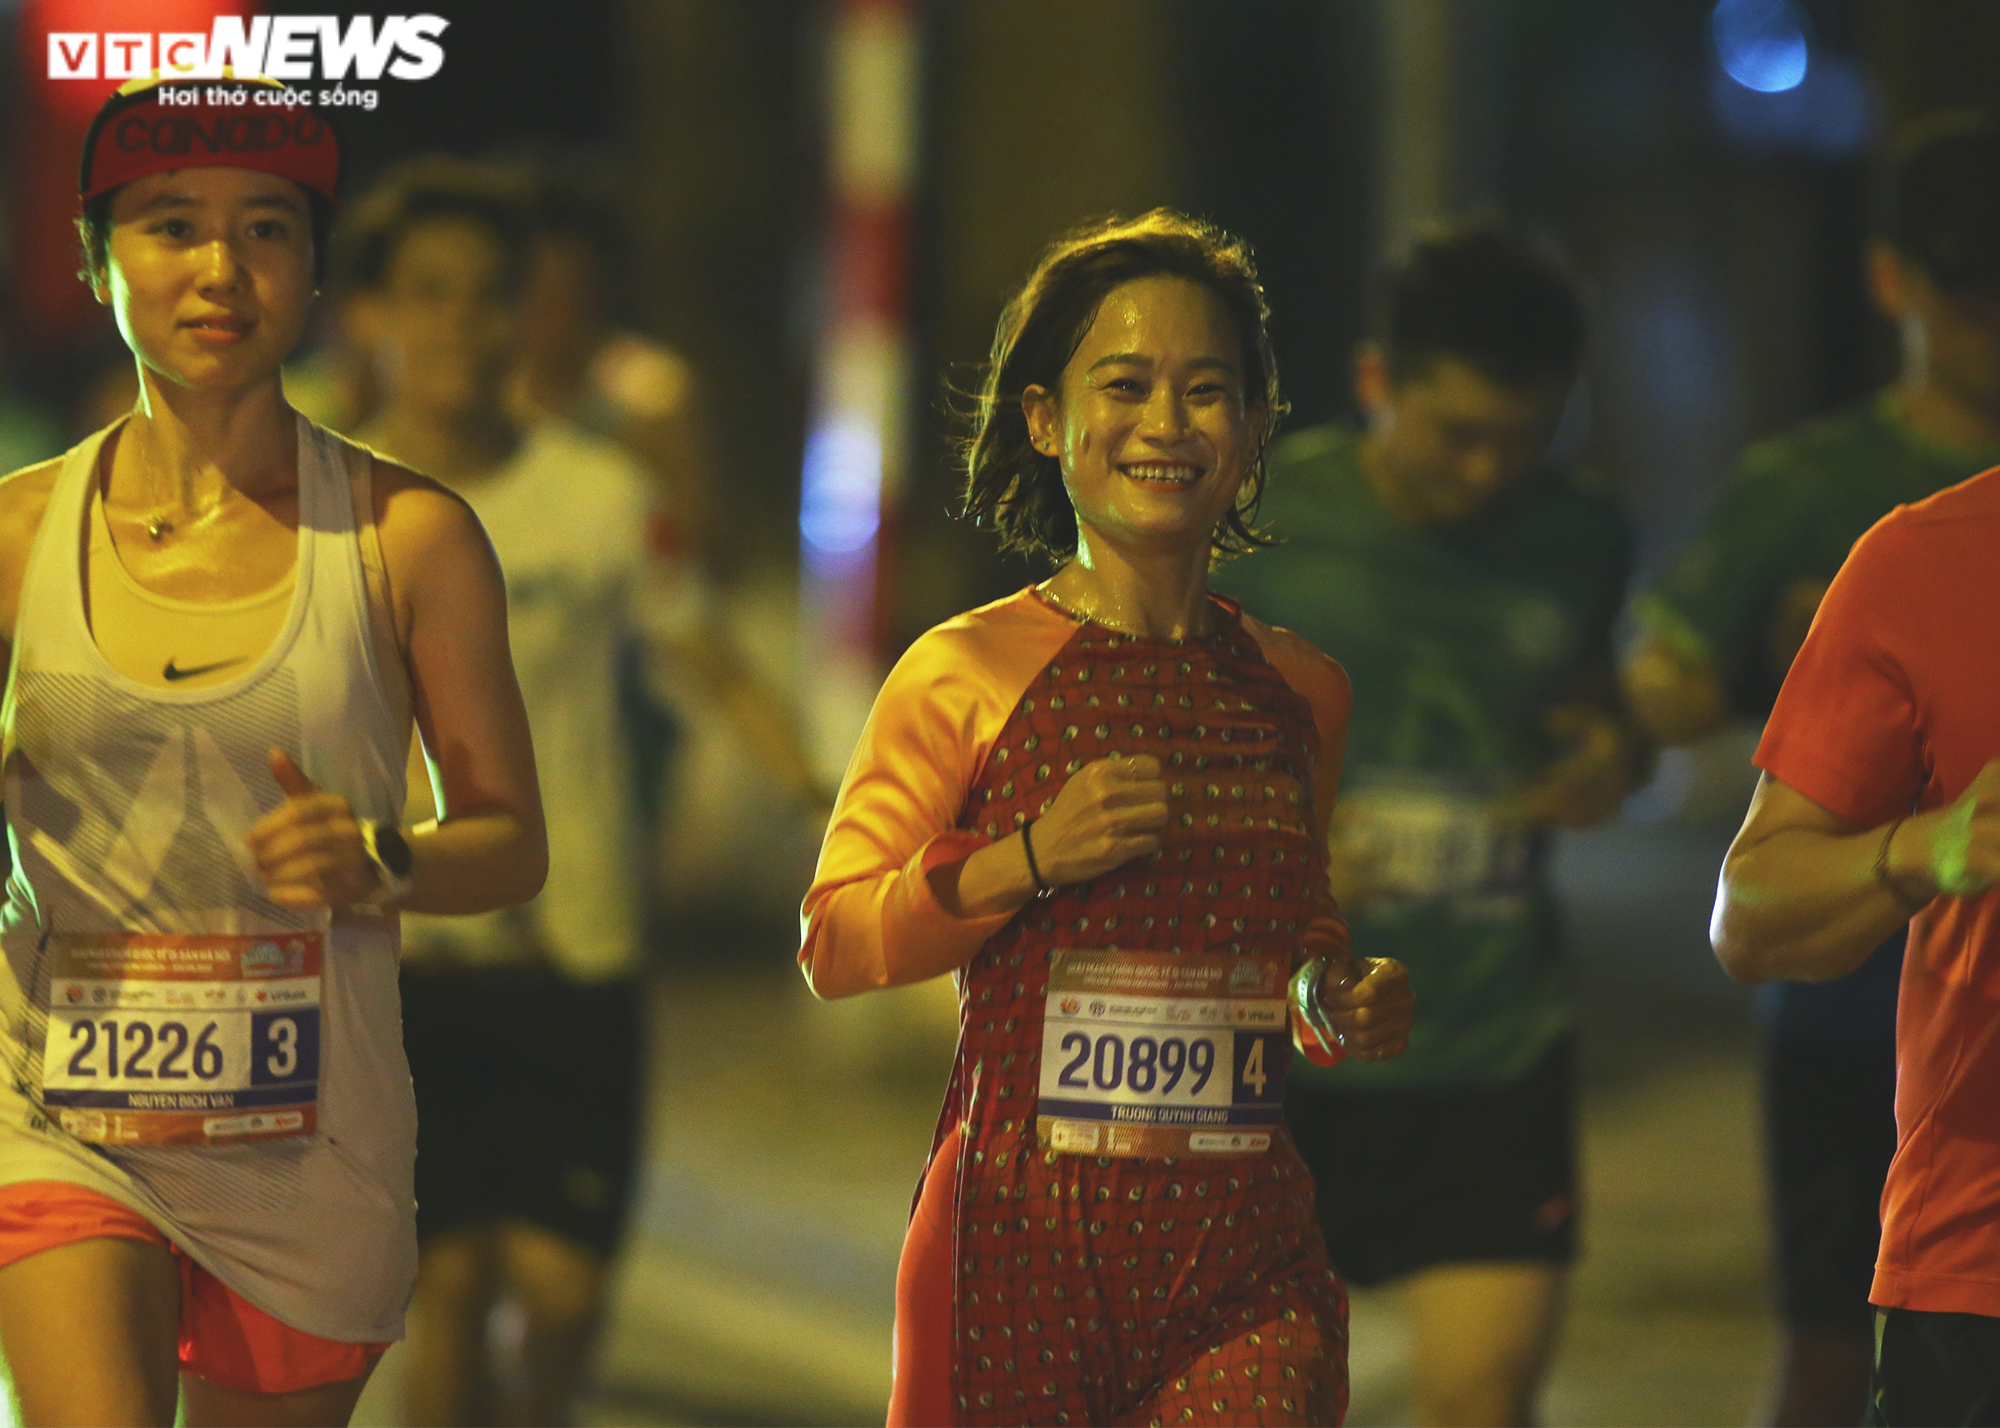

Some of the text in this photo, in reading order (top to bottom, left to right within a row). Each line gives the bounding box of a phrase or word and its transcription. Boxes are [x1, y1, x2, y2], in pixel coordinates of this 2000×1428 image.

[67, 1018, 223, 1080] 21226
[267, 1017, 298, 1077] 3
[1058, 1031, 1215, 1096] 20899
[1242, 1037, 1267, 1097] 4
[209, 1092, 234, 1109] VAN
[1111, 1105, 1228, 1124] TRUONG QUYNH GIANG
